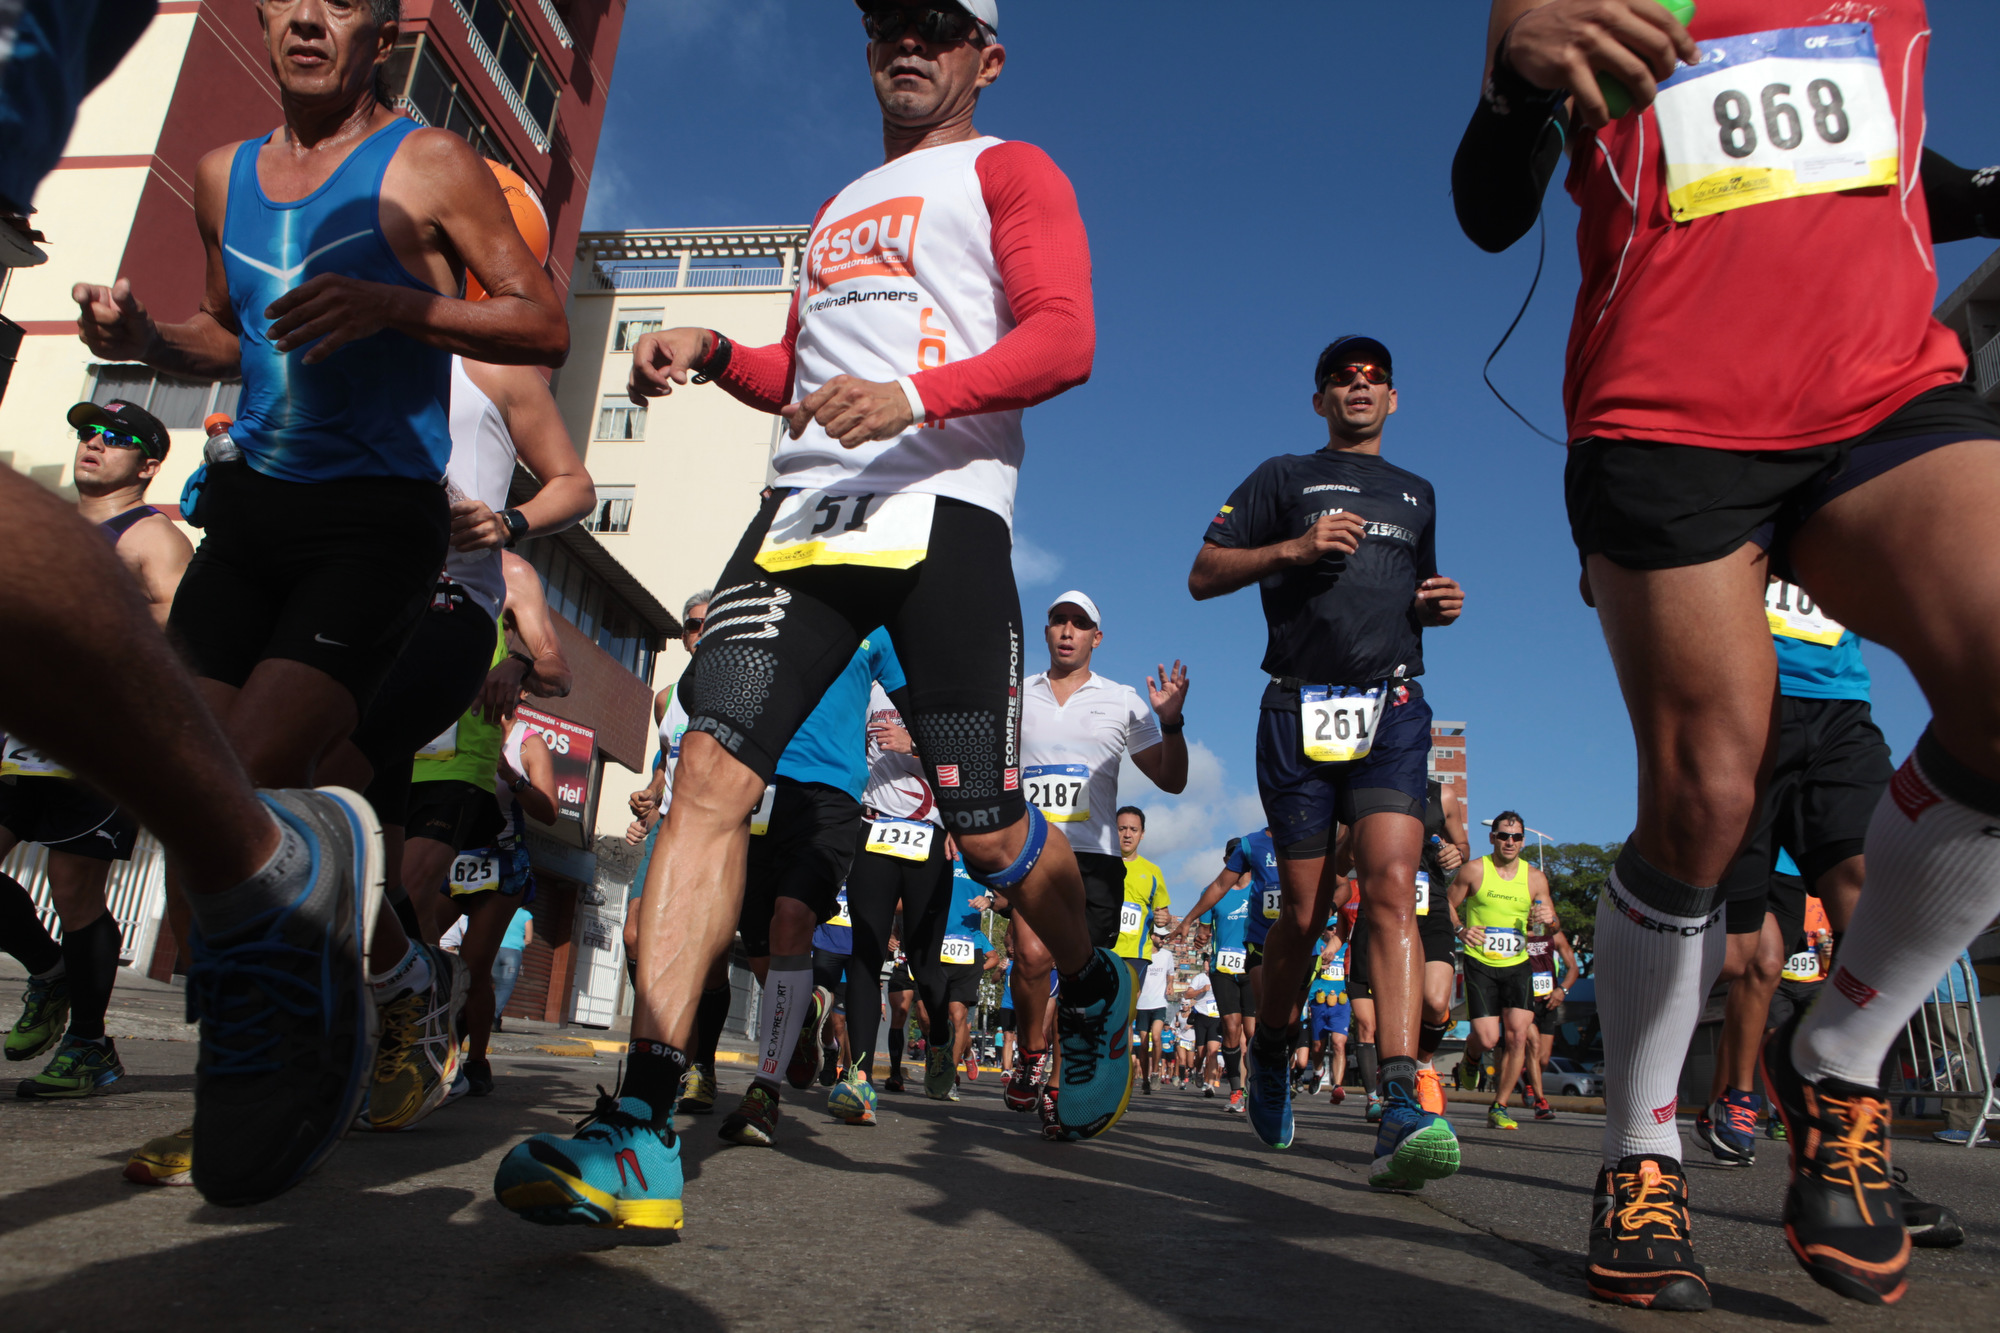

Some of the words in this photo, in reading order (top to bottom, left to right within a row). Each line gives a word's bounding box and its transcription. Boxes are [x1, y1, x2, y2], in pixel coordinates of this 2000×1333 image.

[1713, 78, 1850, 158] 868
[1303, 484, 1360, 495] ENRRIQUE
[811, 493, 875, 535] 51
[1005, 629, 1019, 767] COMPRESSPORT
[517, 706, 556, 725] SUSPENSIÓN
[559, 721, 594, 739] REPUESTOS
[517, 718, 571, 755] TOS
[557, 783, 581, 804] riel
[1029, 782, 1082, 808] 2187
[876, 828, 926, 849] 1312
[454, 861, 492, 883] 625
[1121, 911, 1137, 926] 80
[942, 942, 970, 956] 2873
[1489, 936, 1521, 952] 2912
[1784, 957, 1817, 971] 995
[767, 984, 787, 1057] COMPRESSPORT
